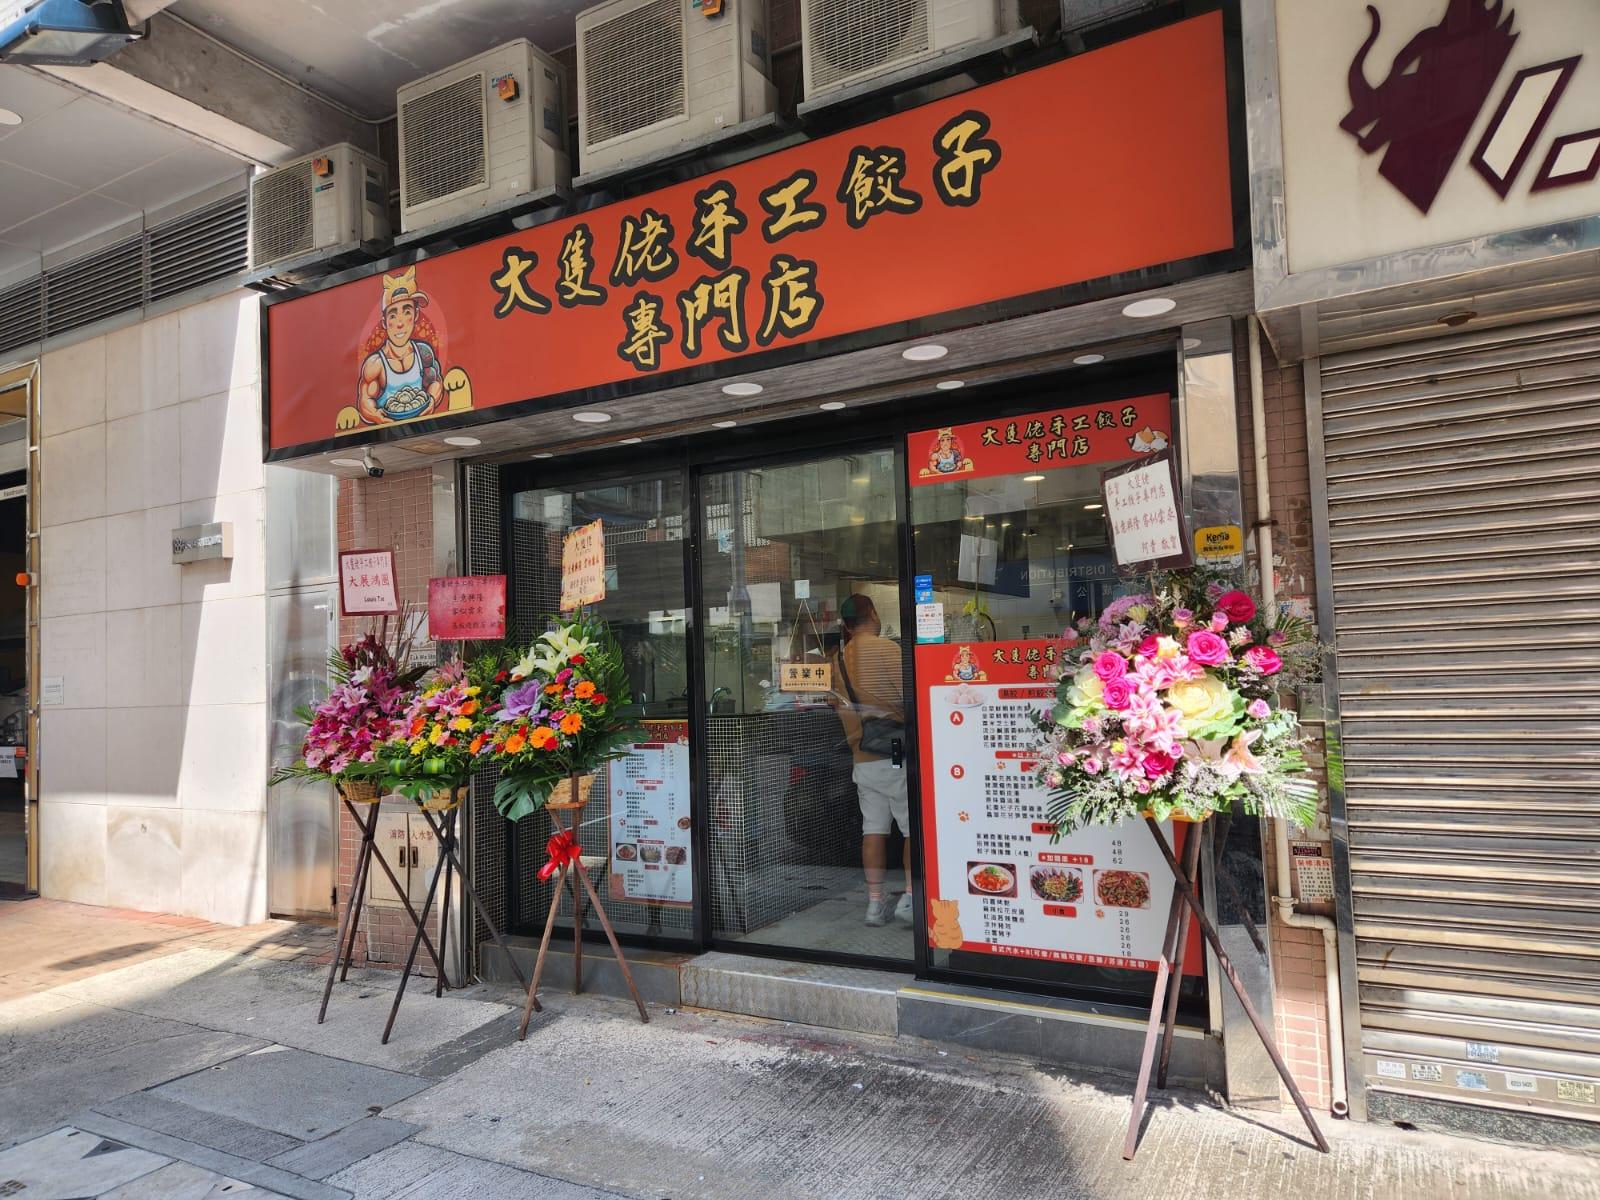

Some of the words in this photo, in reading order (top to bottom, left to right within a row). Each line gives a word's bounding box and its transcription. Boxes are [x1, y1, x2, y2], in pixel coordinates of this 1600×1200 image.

[492, 111, 1001, 317] 大隻佬手工餃子
[620, 256, 824, 370] 專門店
[981, 406, 1139, 447] 大隻佬手工餃子
[1026, 437, 1090, 463] 專門店
[788, 667, 825, 680] 營業中
